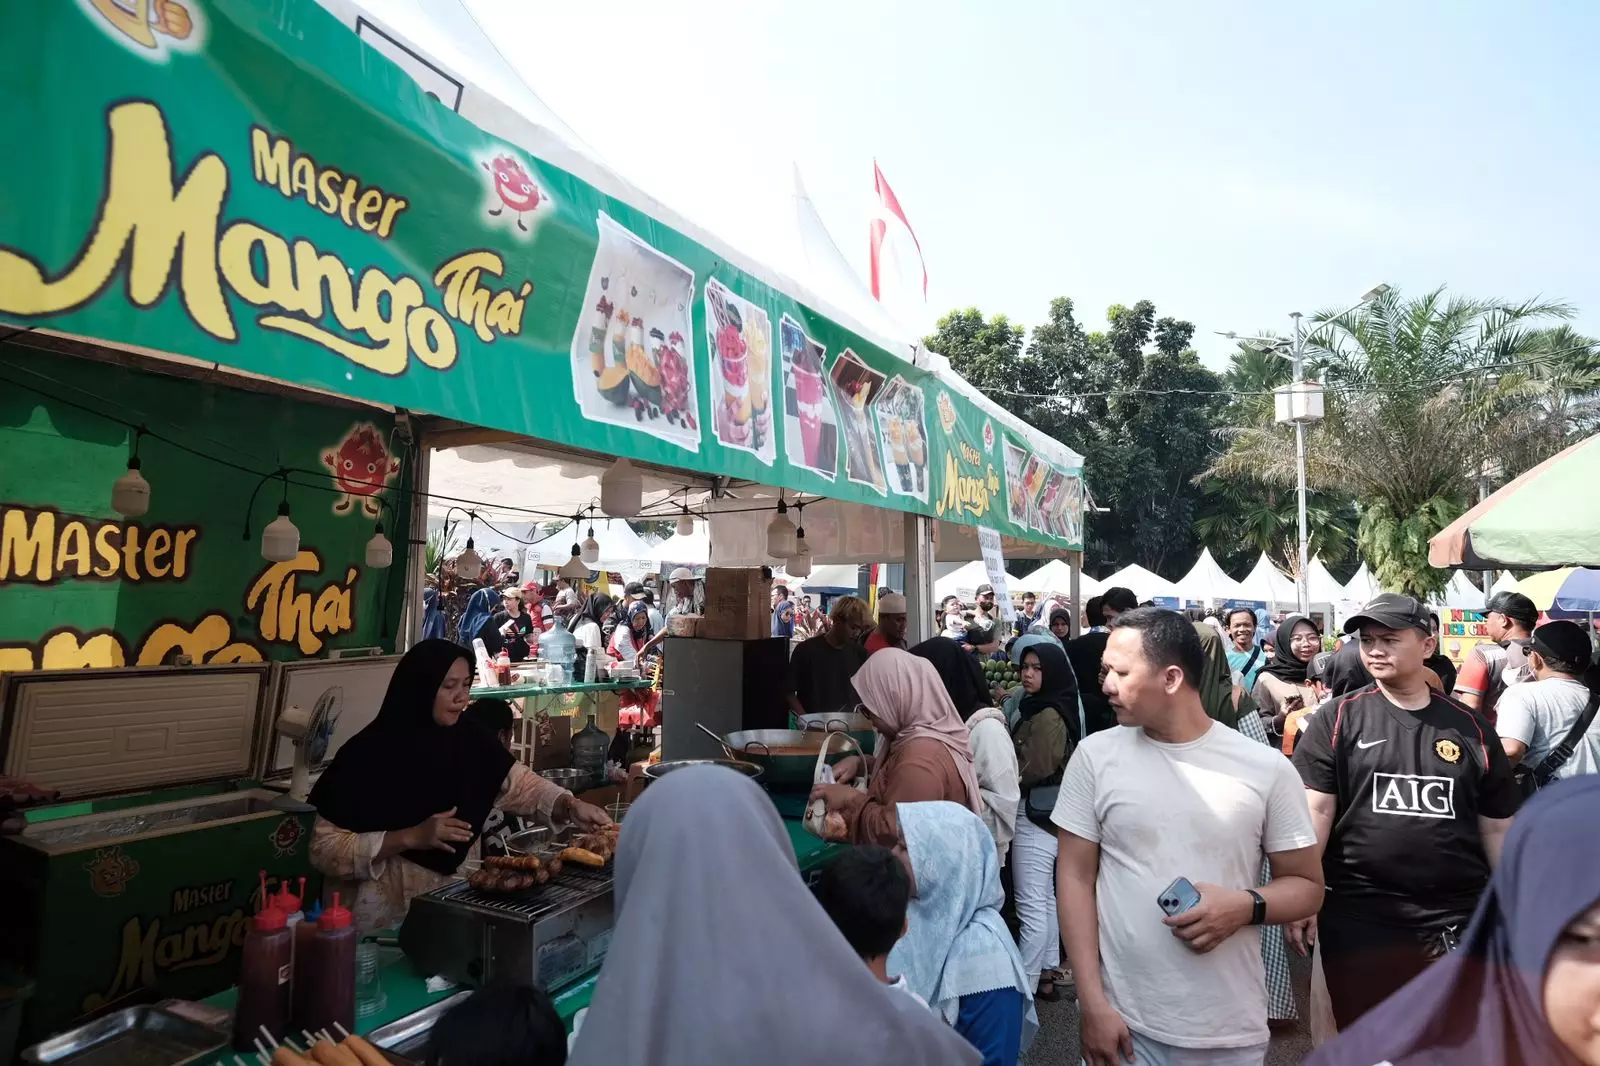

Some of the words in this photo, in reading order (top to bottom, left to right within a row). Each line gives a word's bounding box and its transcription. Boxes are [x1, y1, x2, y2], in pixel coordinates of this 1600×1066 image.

[0, 100, 458, 374] Mango
[433, 250, 533, 341] Thai
[246, 550, 357, 656] Thai
[1443, 623, 1465, 636] ICE
[1450, 608, 1488, 623] NIN
[1378, 778, 1450, 813] AIG
[83, 907, 252, 1014] Mango
